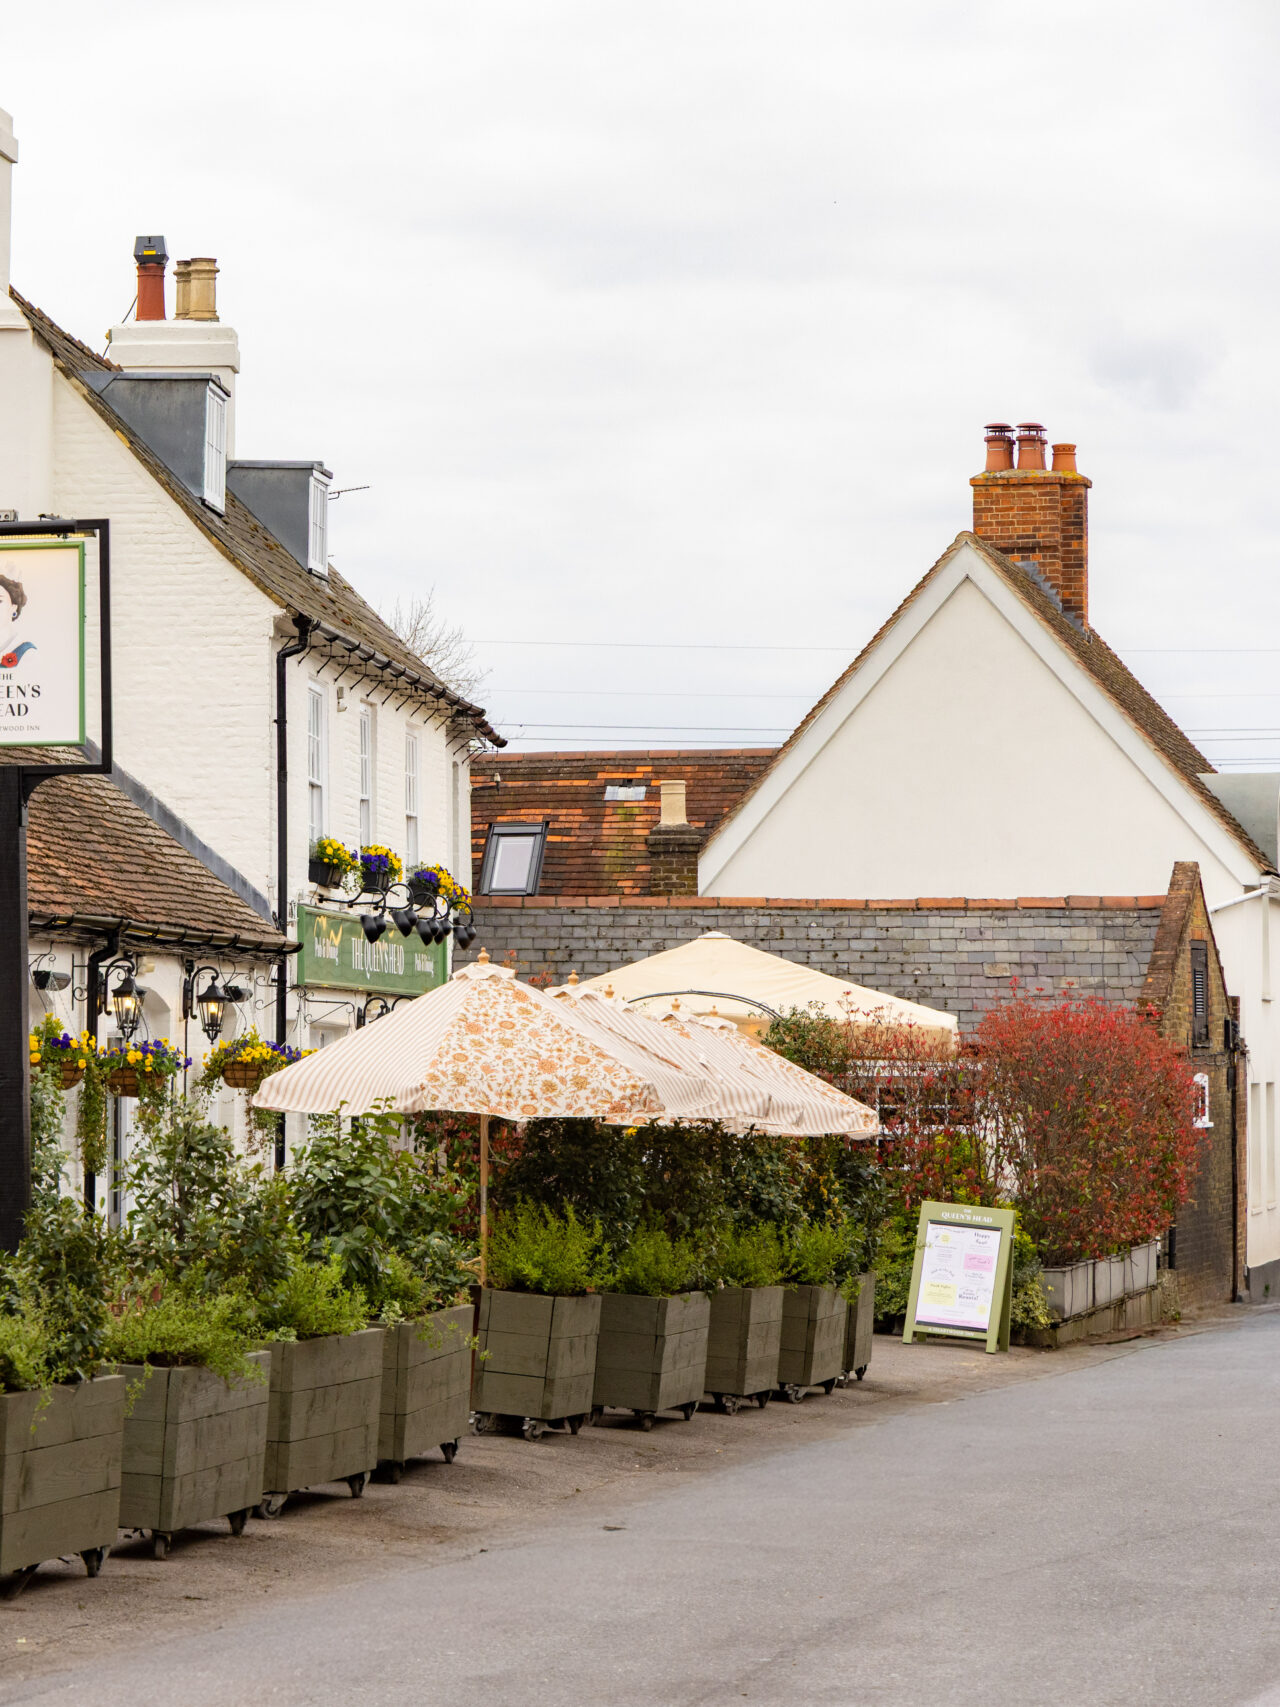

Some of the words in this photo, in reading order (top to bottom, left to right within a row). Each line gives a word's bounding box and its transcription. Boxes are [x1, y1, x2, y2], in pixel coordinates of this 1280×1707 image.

[351, 937, 364, 970] THE
[364, 939, 389, 980] QUEEN'S
[389, 943, 405, 975] HEAD
[941, 1211, 971, 1220] QUEEN'S
[972, 1215, 993, 1223] HEAD
